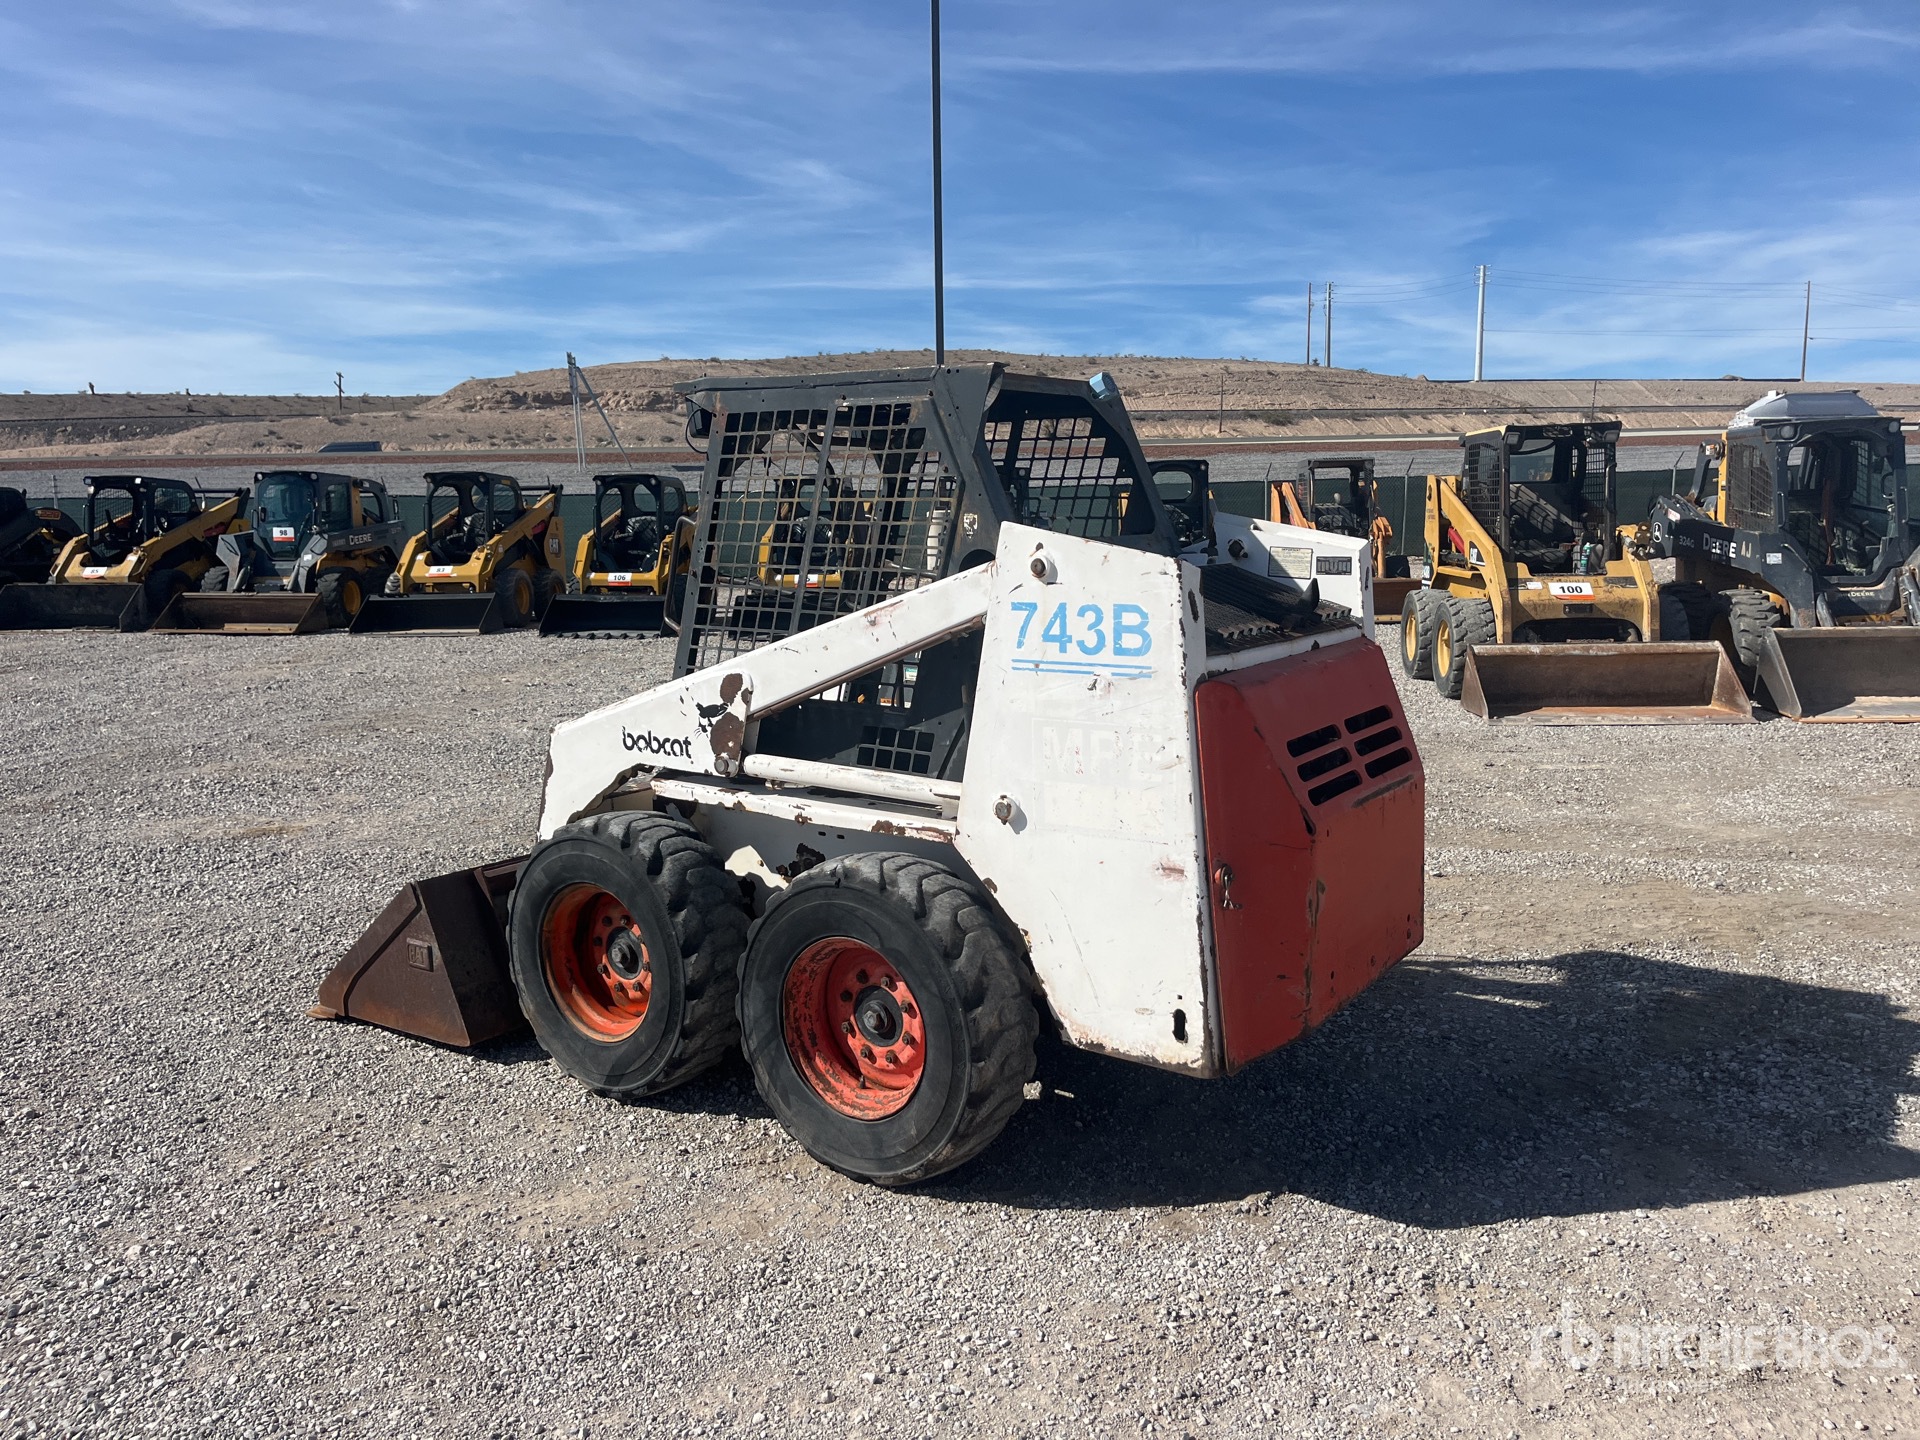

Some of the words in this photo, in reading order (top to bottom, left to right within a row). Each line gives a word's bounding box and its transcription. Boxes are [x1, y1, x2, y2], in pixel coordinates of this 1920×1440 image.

[349, 533, 372, 546] DEERE
[1703, 533, 1737, 558] DEERE
[1559, 585, 1583, 594] 100
[1011, 601, 1152, 657] 743B
[622, 725, 692, 759] bobcat
